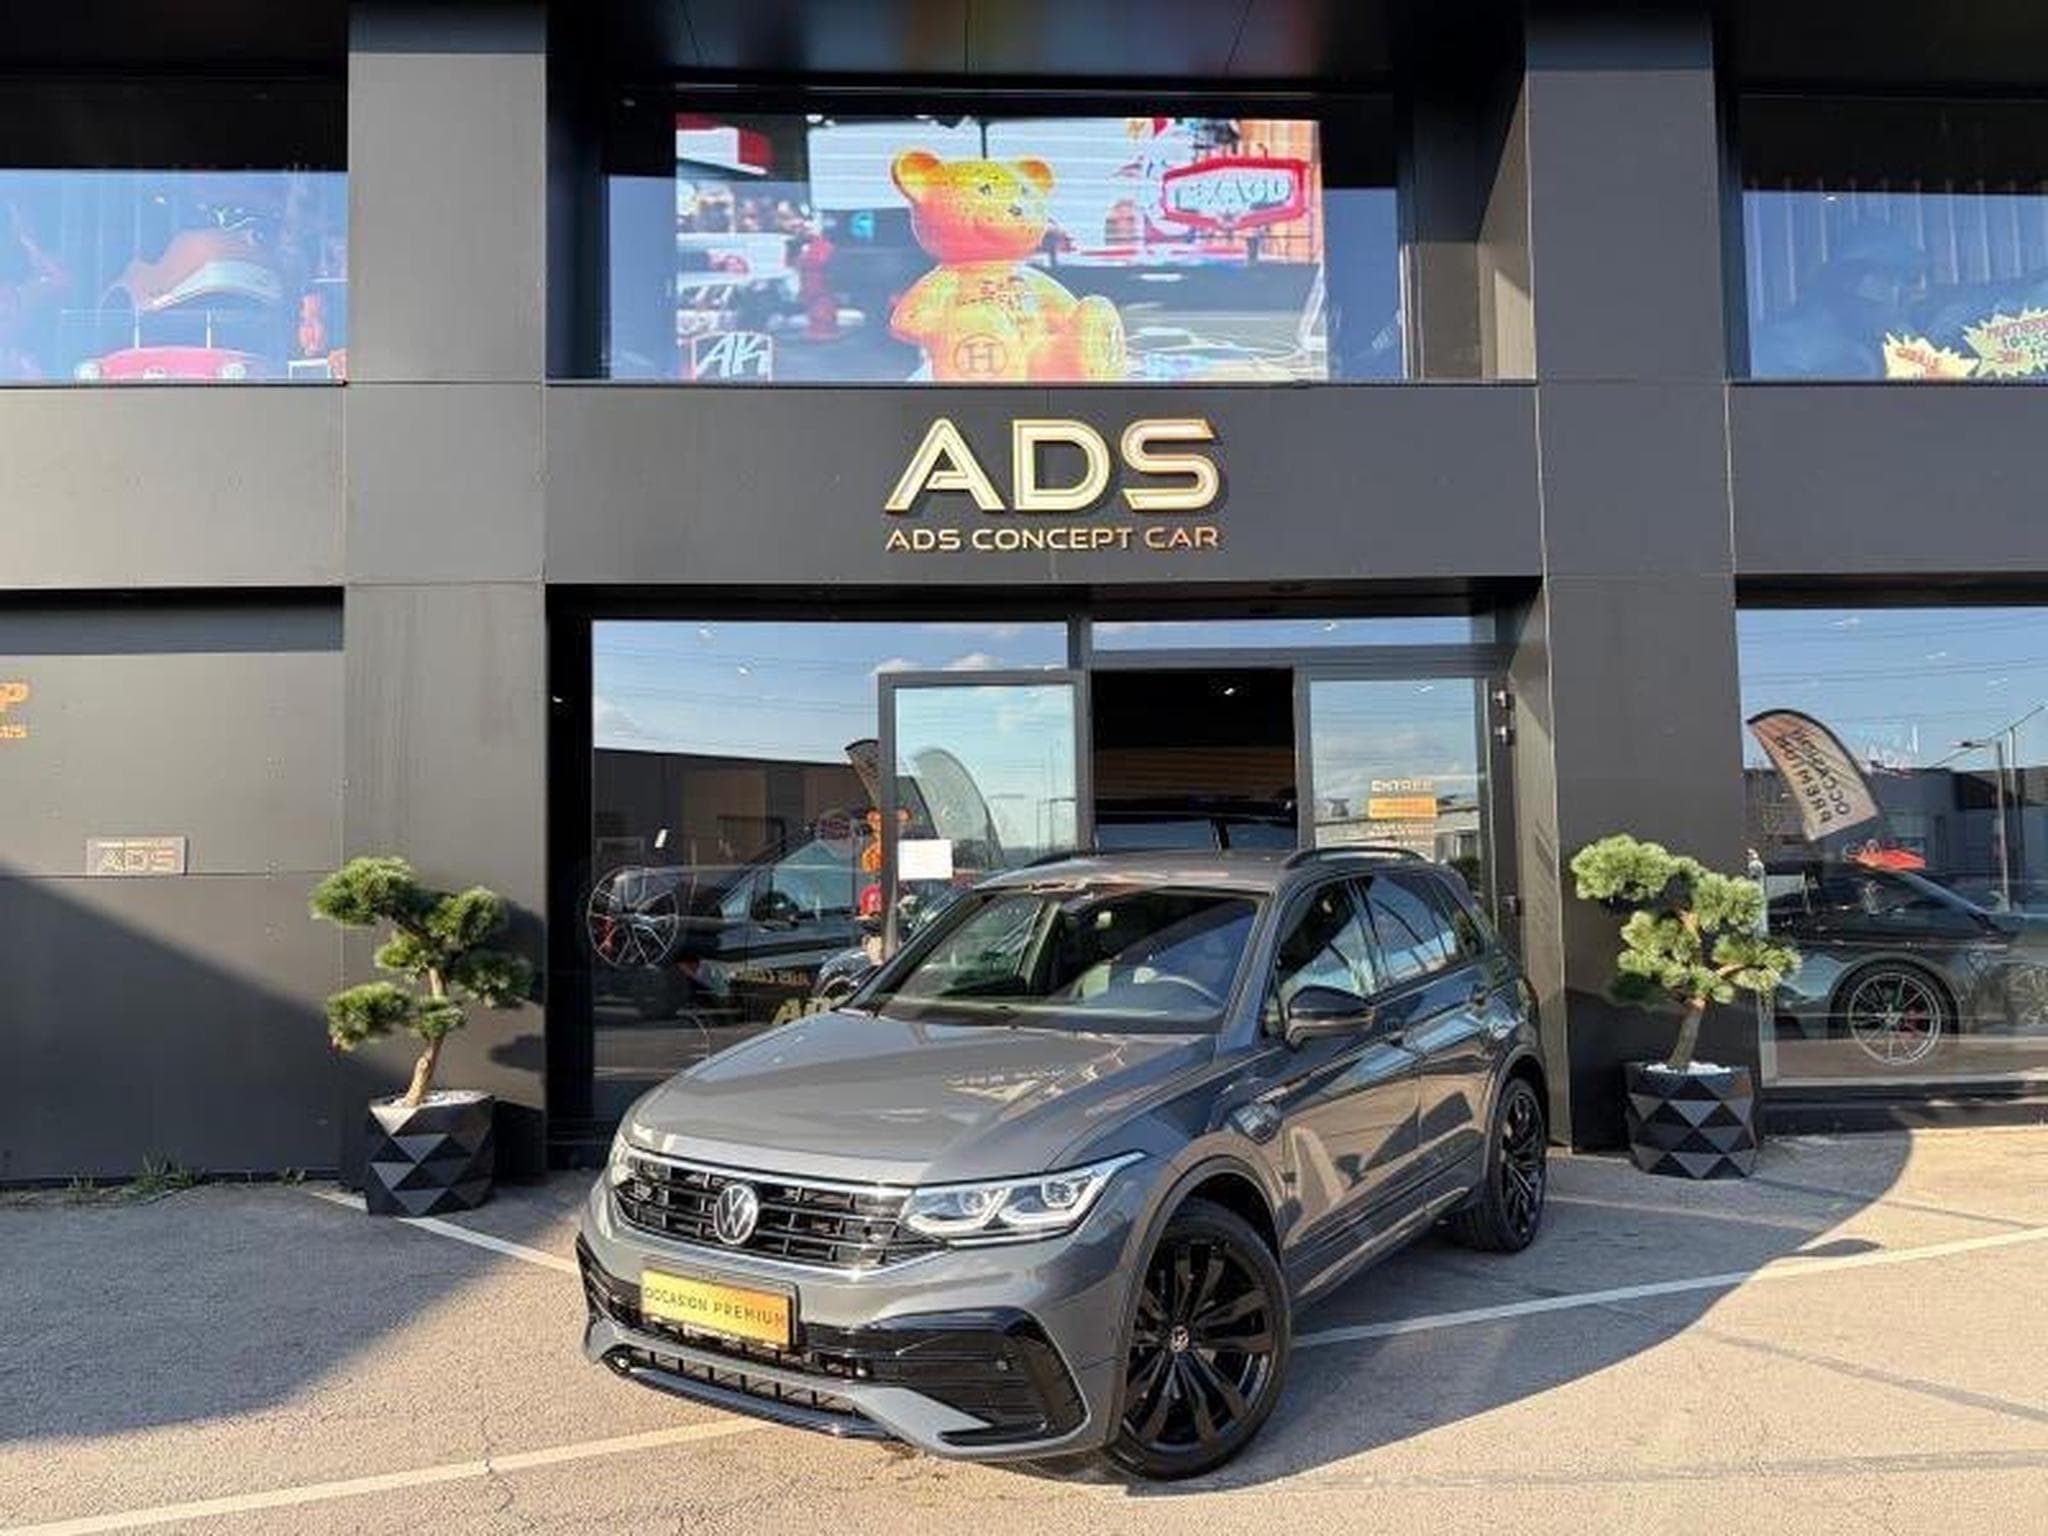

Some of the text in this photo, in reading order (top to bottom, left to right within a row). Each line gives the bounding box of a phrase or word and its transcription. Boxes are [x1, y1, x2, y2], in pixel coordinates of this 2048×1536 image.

[885, 417, 1220, 511] ADS
[886, 527, 1219, 550] ADS CONCEPT CAR
[713, 1300, 785, 1327] PREMIUM
